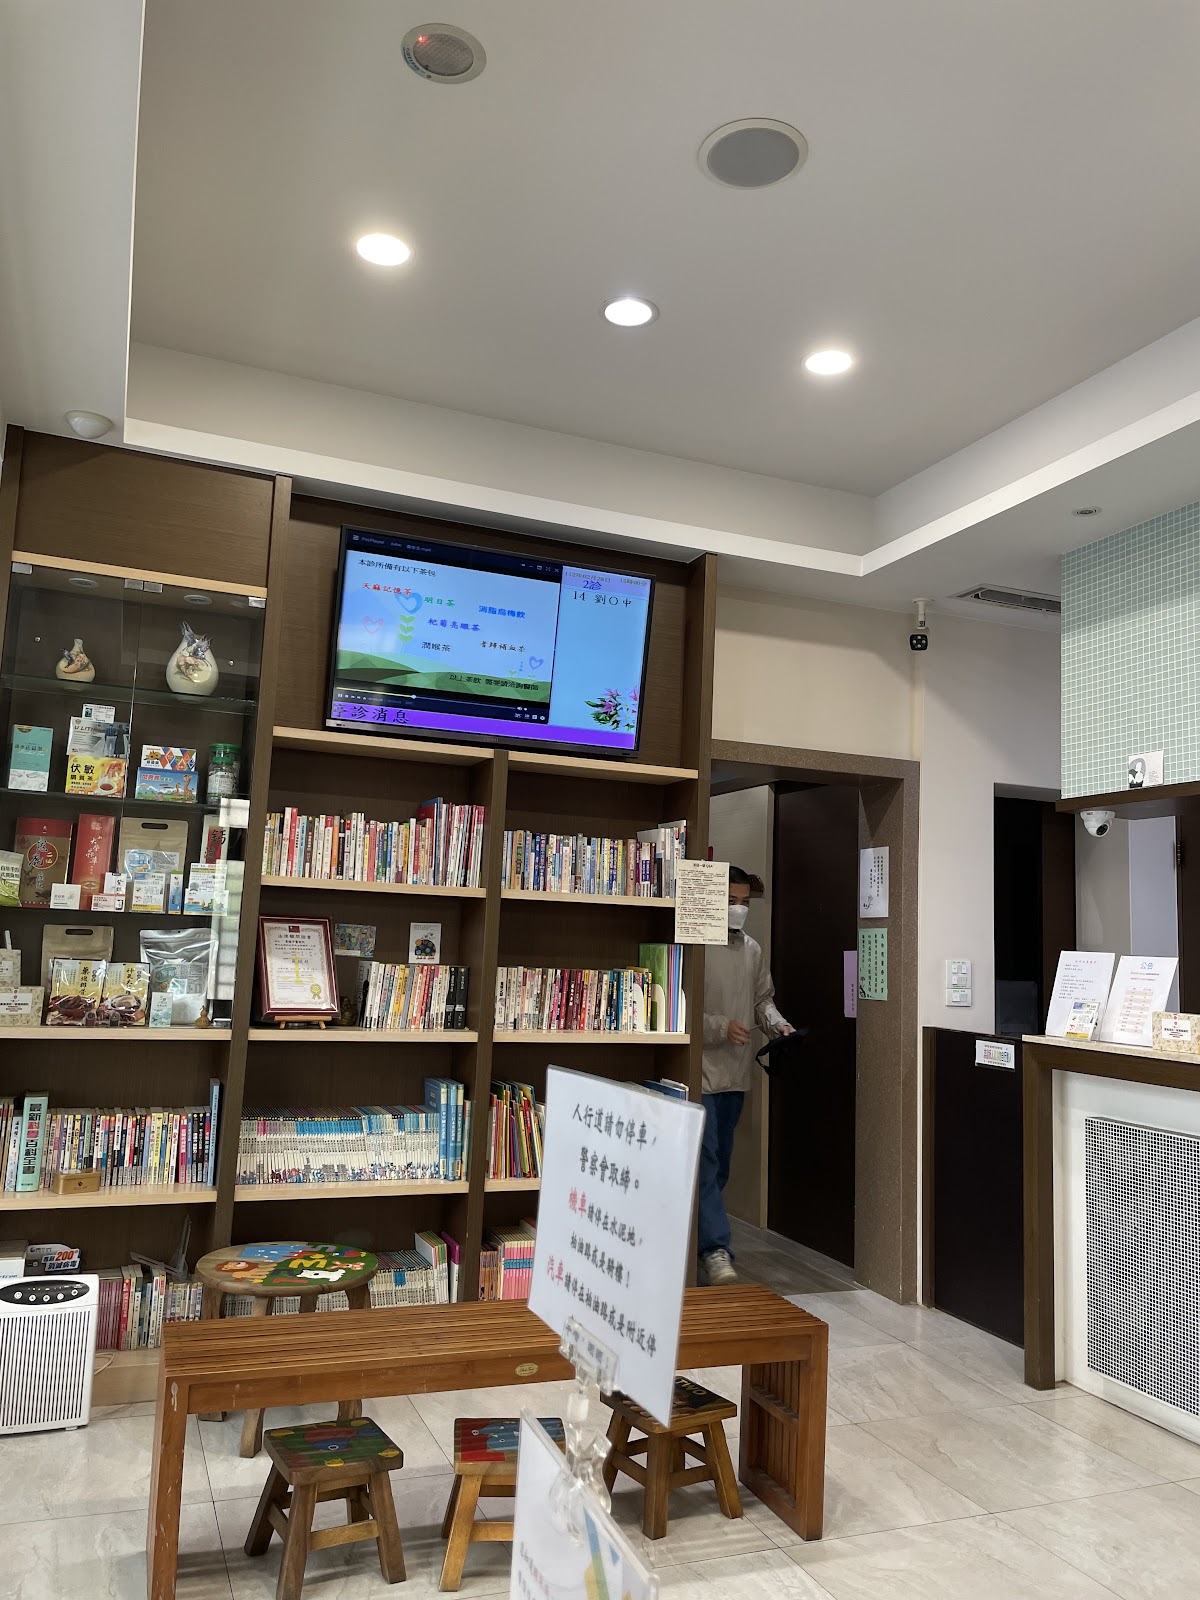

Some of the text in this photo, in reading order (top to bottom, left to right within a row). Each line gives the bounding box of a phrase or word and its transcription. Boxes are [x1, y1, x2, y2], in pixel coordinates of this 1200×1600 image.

[358, 558, 436, 577] 本診所備有以下茶包
[583, 580, 602, 590] 2診
[573, 590, 586, 601] 14
[424, 596, 456, 607] 明日茶
[421, 641, 451, 652] 潤喉茶
